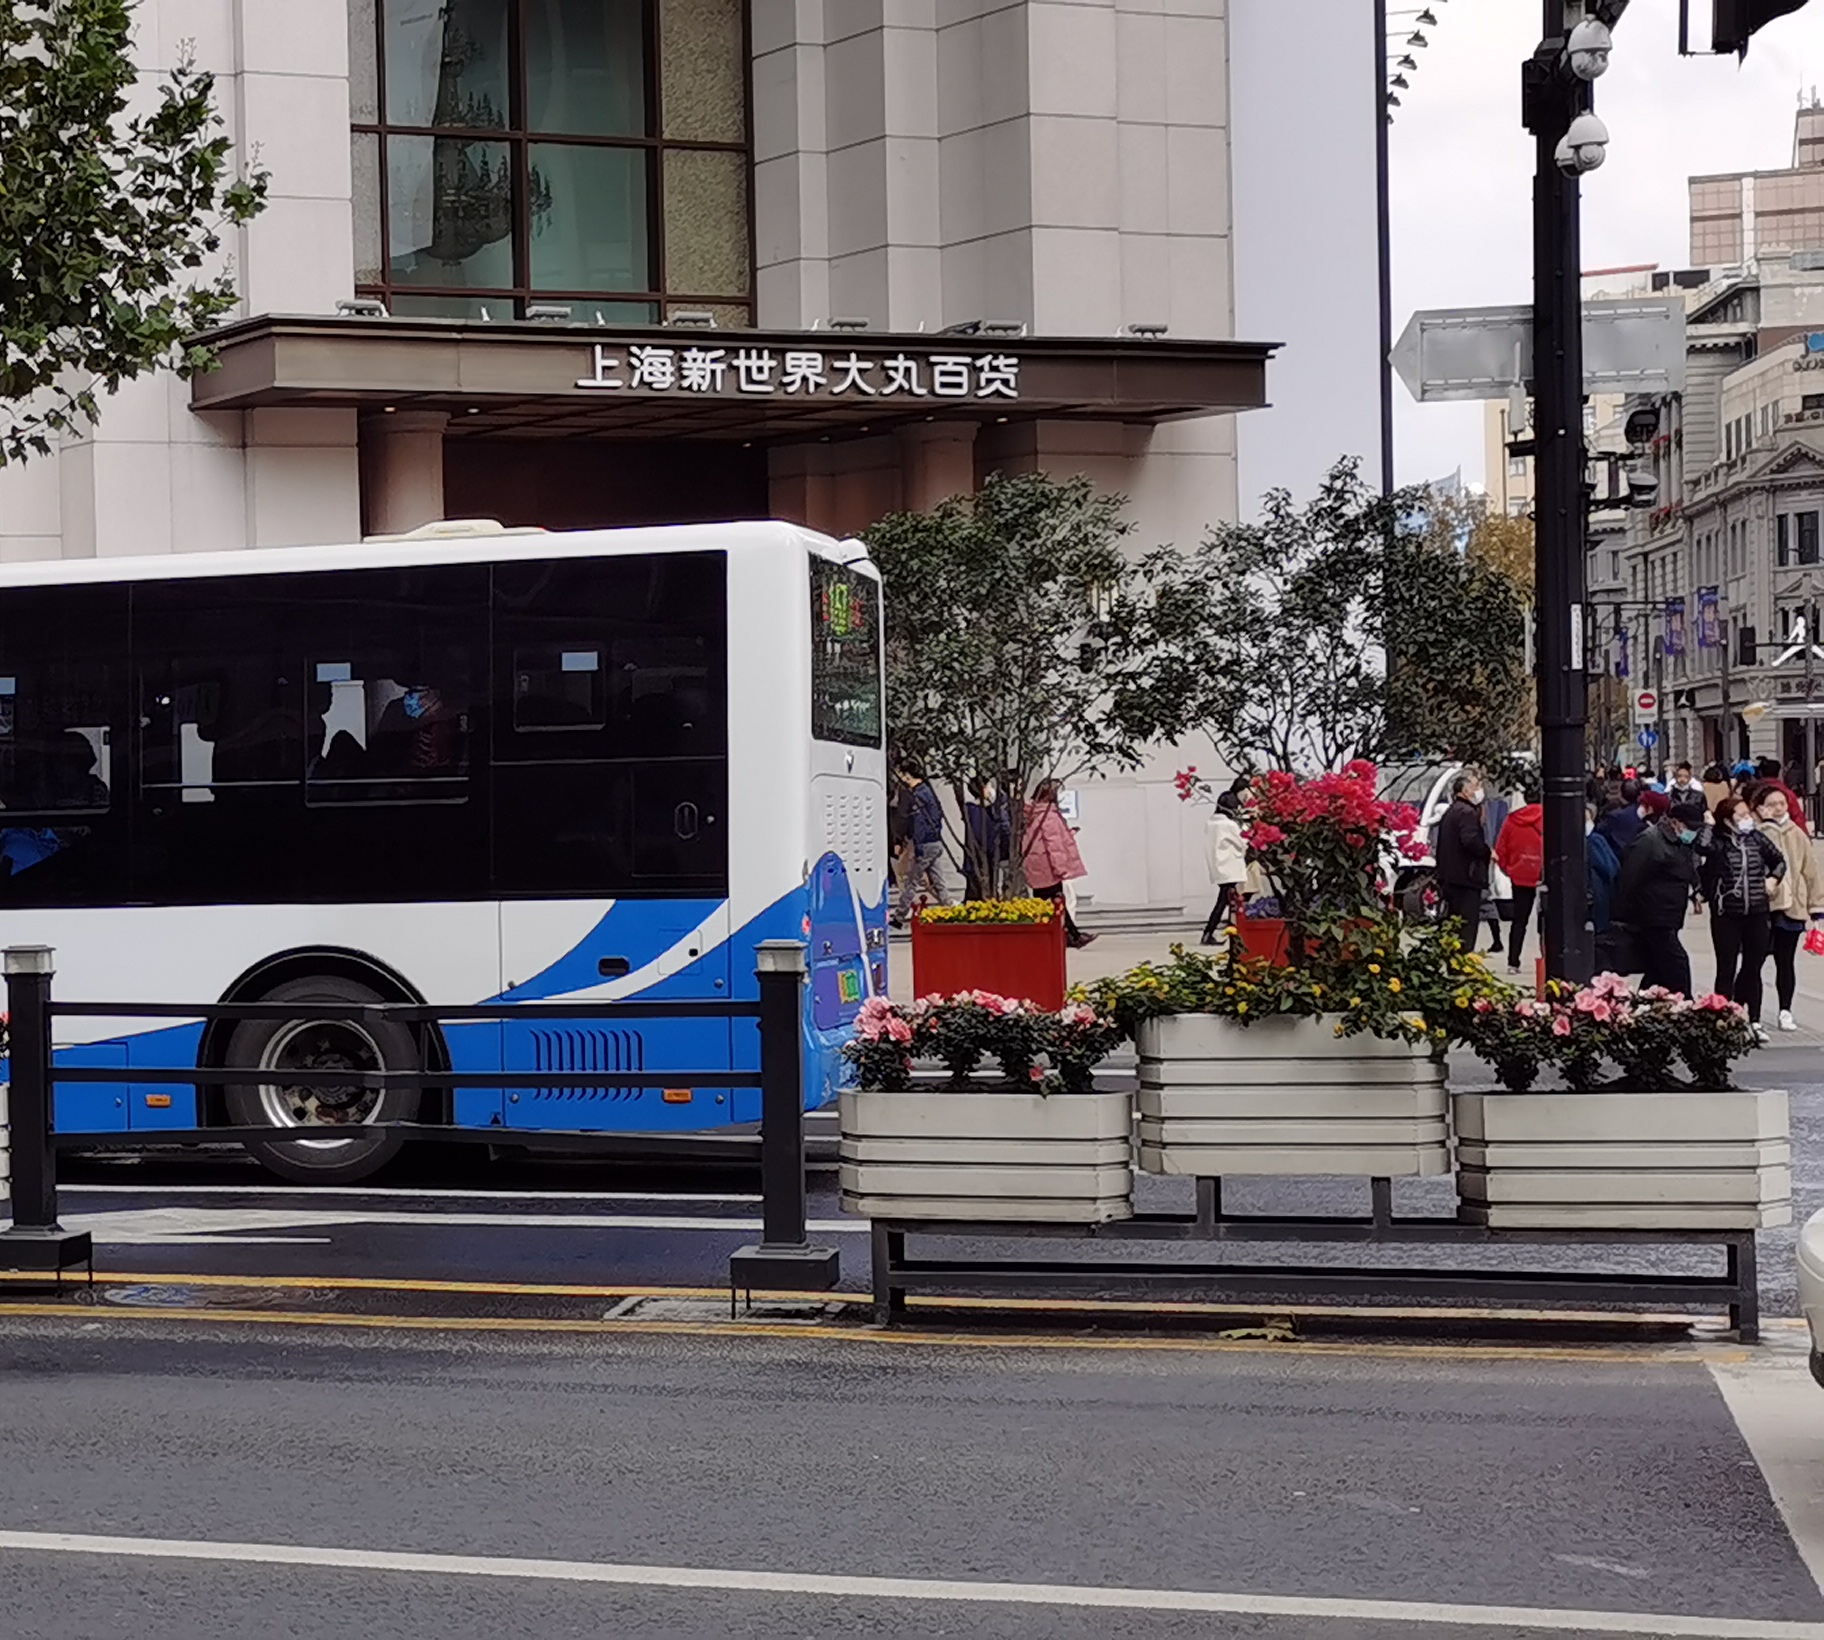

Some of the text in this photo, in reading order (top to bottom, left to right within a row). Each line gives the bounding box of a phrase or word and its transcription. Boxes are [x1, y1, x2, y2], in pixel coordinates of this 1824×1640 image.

[575, 344, 1020, 399] 上海新世界大丸百货
